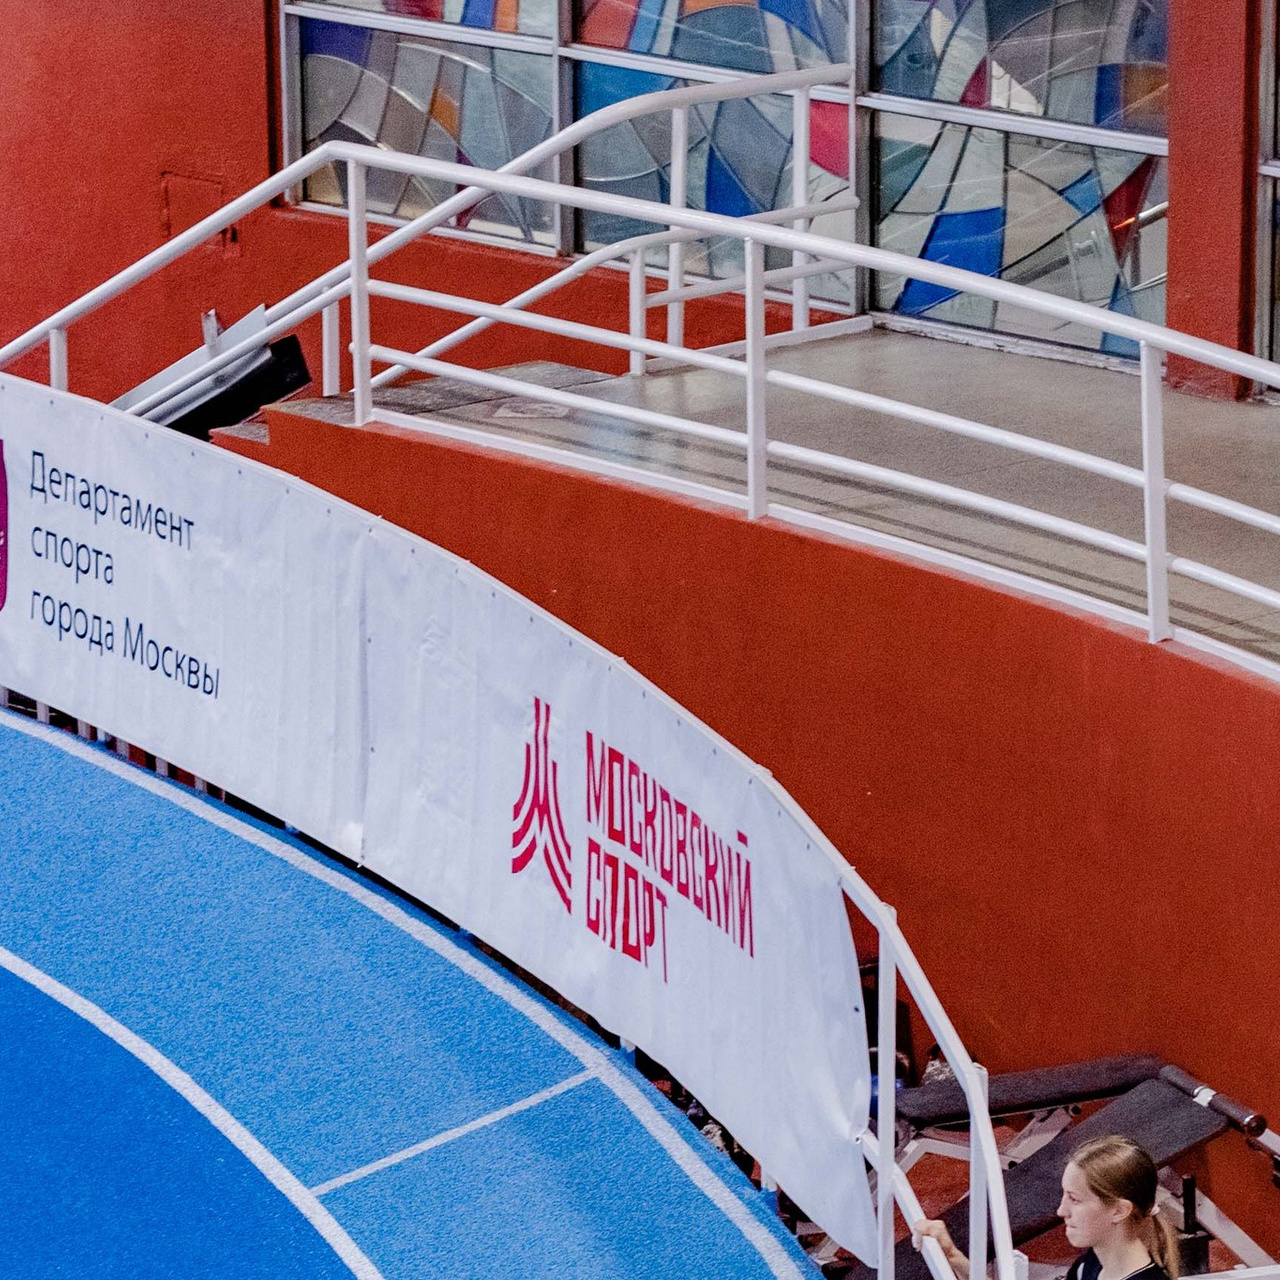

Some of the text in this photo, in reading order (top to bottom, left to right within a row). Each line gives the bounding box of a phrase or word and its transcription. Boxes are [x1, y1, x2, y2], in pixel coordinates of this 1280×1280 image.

[30, 450, 194, 549] Департамент
[31, 526, 114, 584] спорта
[30, 590, 220, 699] города Москвы
[586, 731, 754, 958] МОСКОВСКИЙ
[586, 837, 668, 983] СПОРТ
